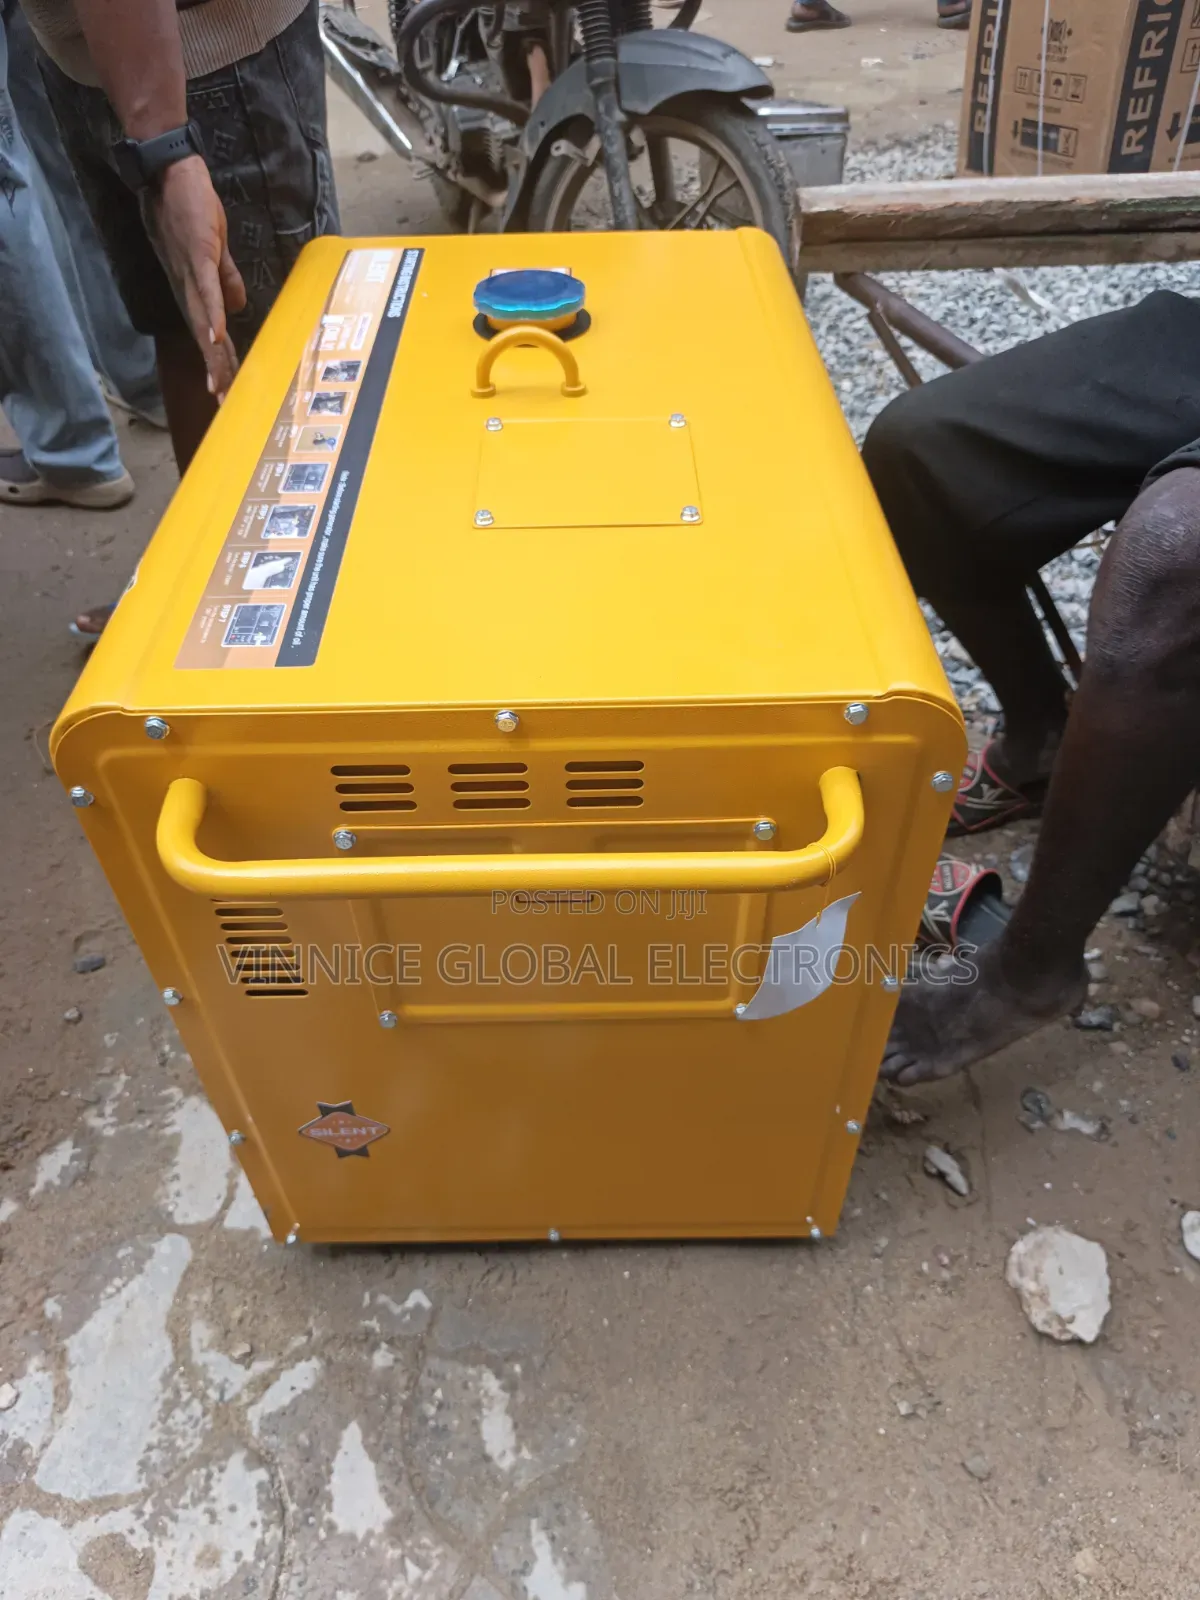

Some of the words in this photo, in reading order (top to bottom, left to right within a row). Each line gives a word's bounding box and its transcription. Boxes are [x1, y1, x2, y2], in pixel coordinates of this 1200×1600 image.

[974, 0, 999, 133] REFRI
[1121, 0, 1172, 155] REFRI
[303, 591, 314, 610] proper
[296, 609, 308, 631] amount
[310, 1126, 378, 1137] SILENT
